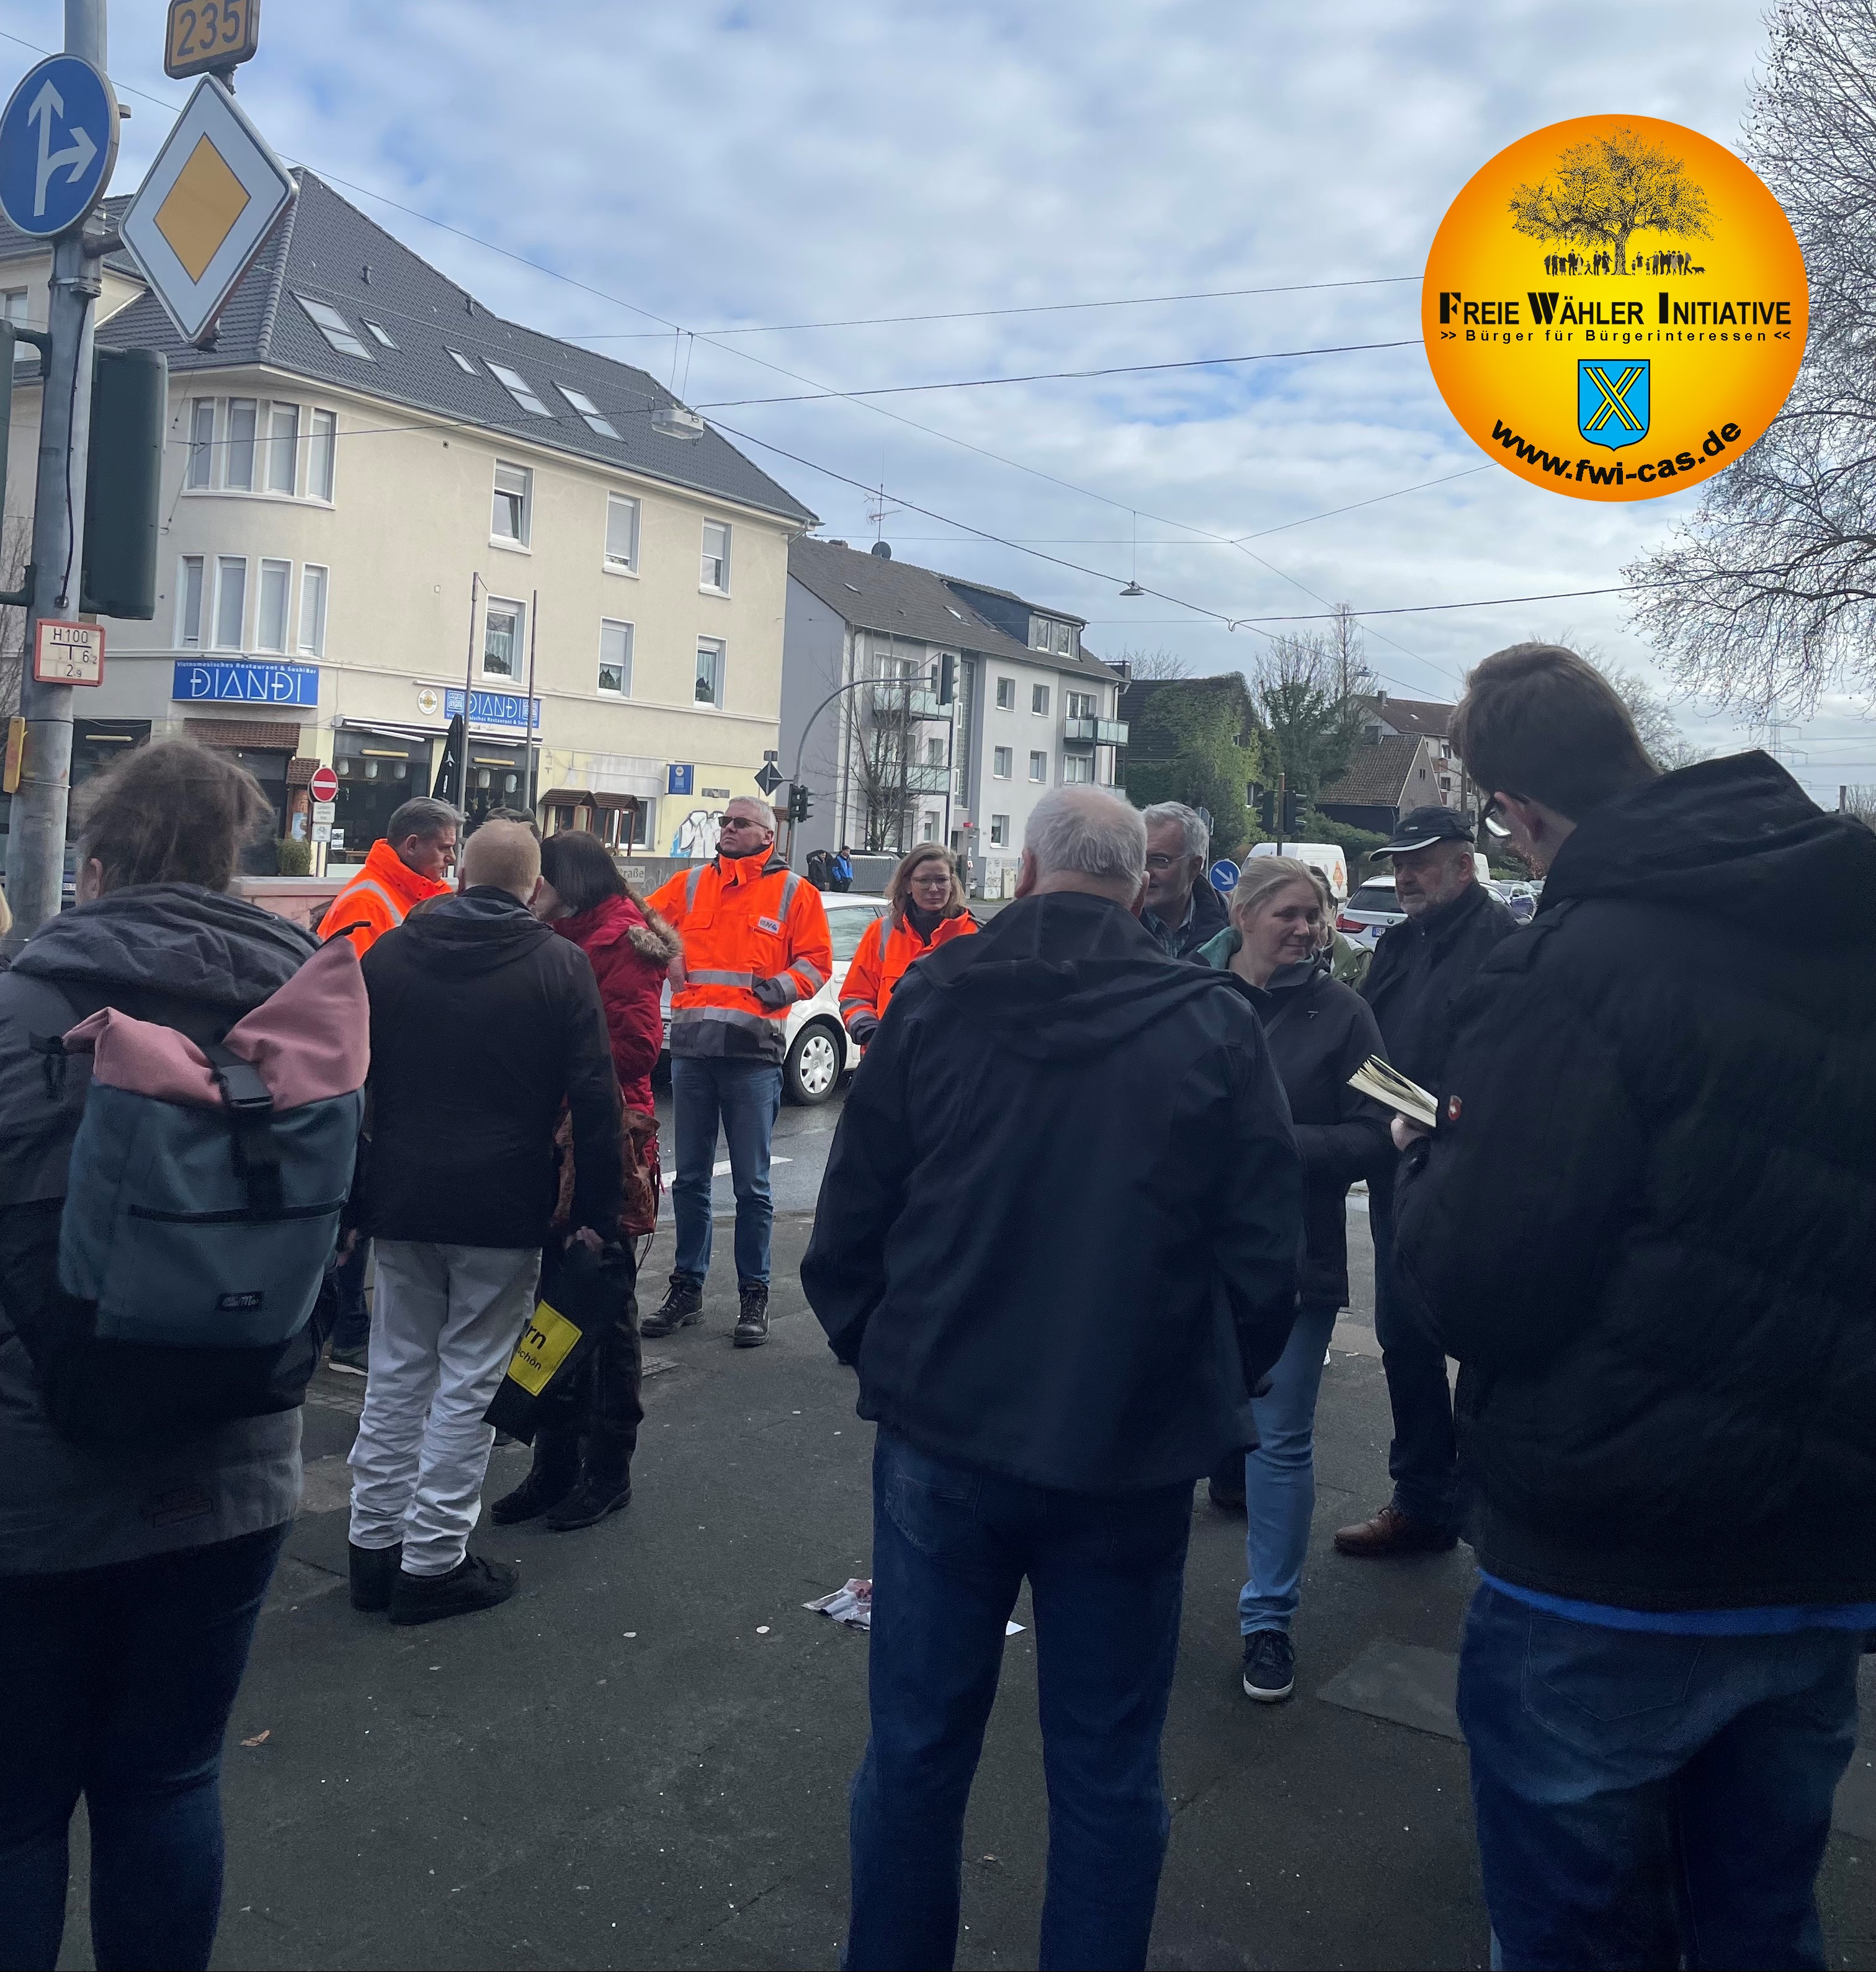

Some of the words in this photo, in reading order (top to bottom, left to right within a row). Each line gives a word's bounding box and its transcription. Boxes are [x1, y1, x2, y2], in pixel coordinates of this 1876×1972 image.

[177, 0, 240, 57] 235
[235, 662, 278, 671] Restaurant
[487, 716, 512, 725] Restaurant
